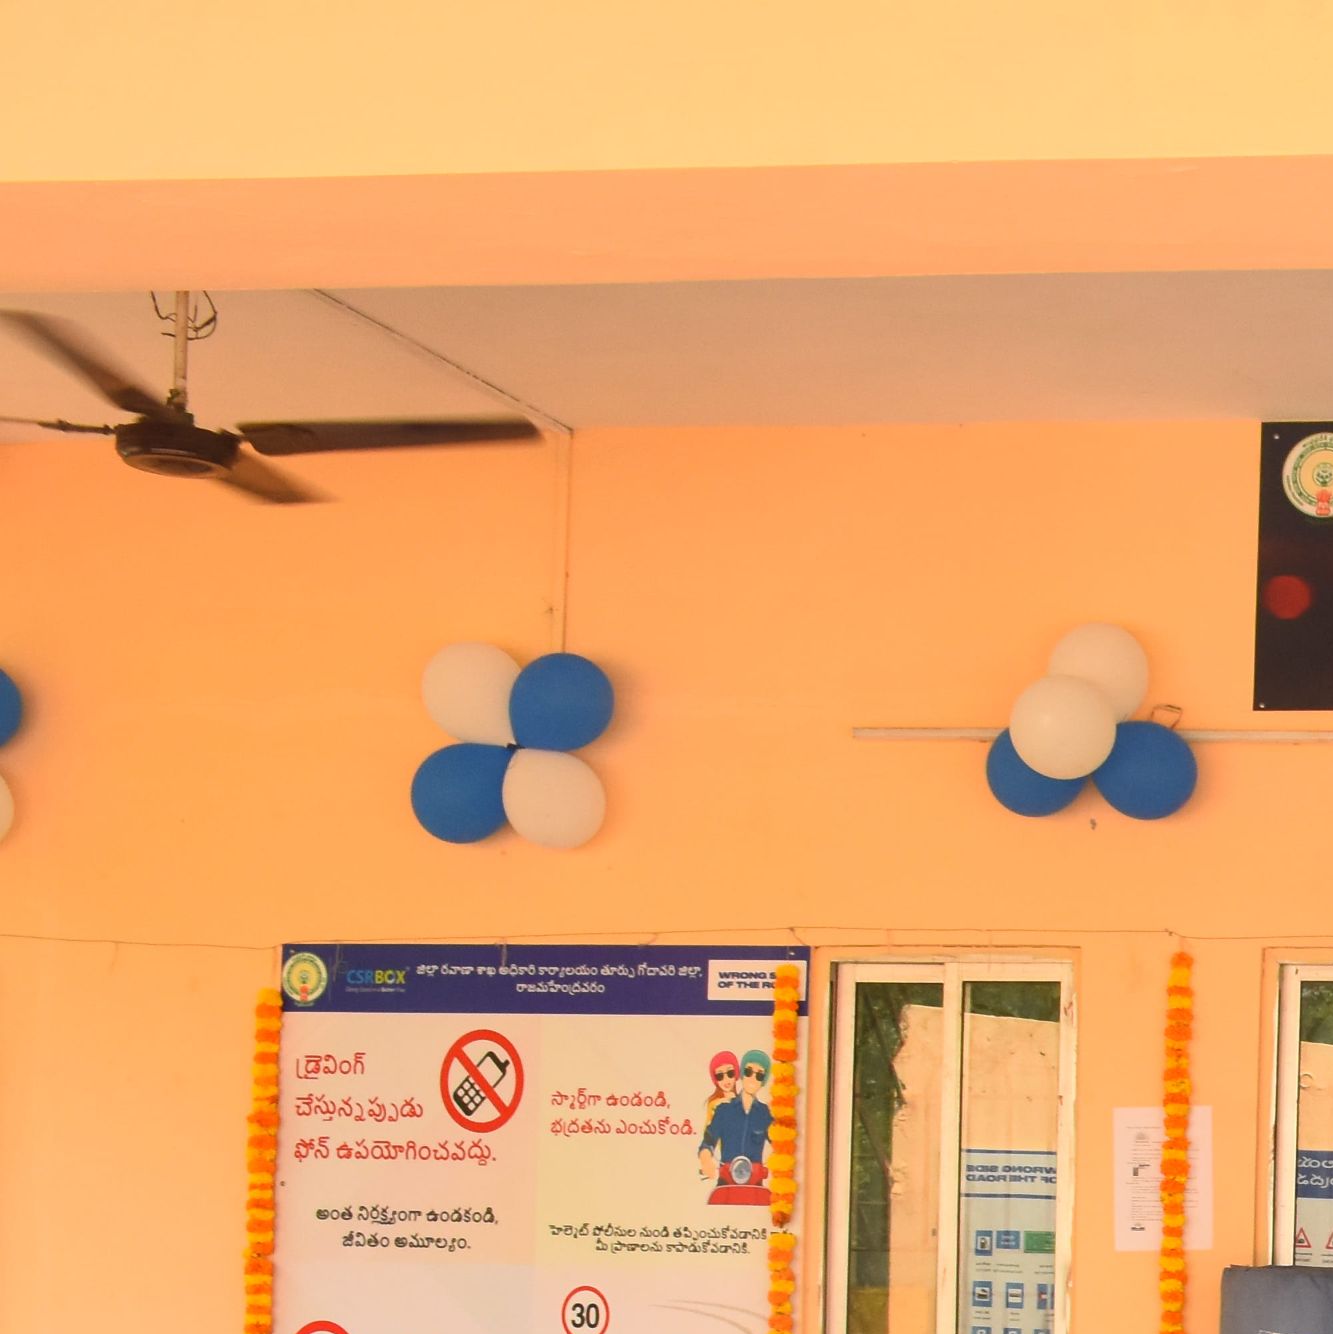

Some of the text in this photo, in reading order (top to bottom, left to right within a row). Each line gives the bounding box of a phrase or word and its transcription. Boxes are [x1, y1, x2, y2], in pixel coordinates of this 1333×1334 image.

[346, 969, 406, 984] CSRBOX
[416, 963, 439, 976] జిల్లా
[440, 963, 474, 975] రవాణా
[538, 963, 598, 978] కార్యాలయం
[600, 964, 635, 978] తూర్పు
[637, 962, 676, 976] గోదావరి
[718, 971, 766, 981] WRONG
[516, 979, 605, 996] రాజమహేంద్రవరం
[718, 980, 735, 989] OF
[737, 980, 765, 989] THE
[296, 1052, 366, 1080] డ్రైవింగ్
[295, 1093, 424, 1122] చేస్తున్నప్పుడు
[606, 1091, 670, 1109] ఉండండి,
[550, 1116, 697, 1138] భద్రతను ఎంచుకోండి.
[294, 1136, 497, 1166] ఫోన్ ఉపయోగించవద్దు.
[316, 1206, 353, 1221] అంత
[426, 1206, 498, 1225] ఉండకండి,
[548, 1223, 589, 1239] హెల్మెట్
[592, 1223, 637, 1237] పోలీసుల
[639, 1226, 669, 1238] నుండి
[673, 1226, 767, 1240] తప్పించుకోవడానికి
[341, 1230, 471, 1252] జీవితం అమూల్యం.
[596, 1238, 608, 1251] మీ
[610, 1240, 662, 1254] ప్రాణాలను
[571, 1303, 599, 1328] 30
